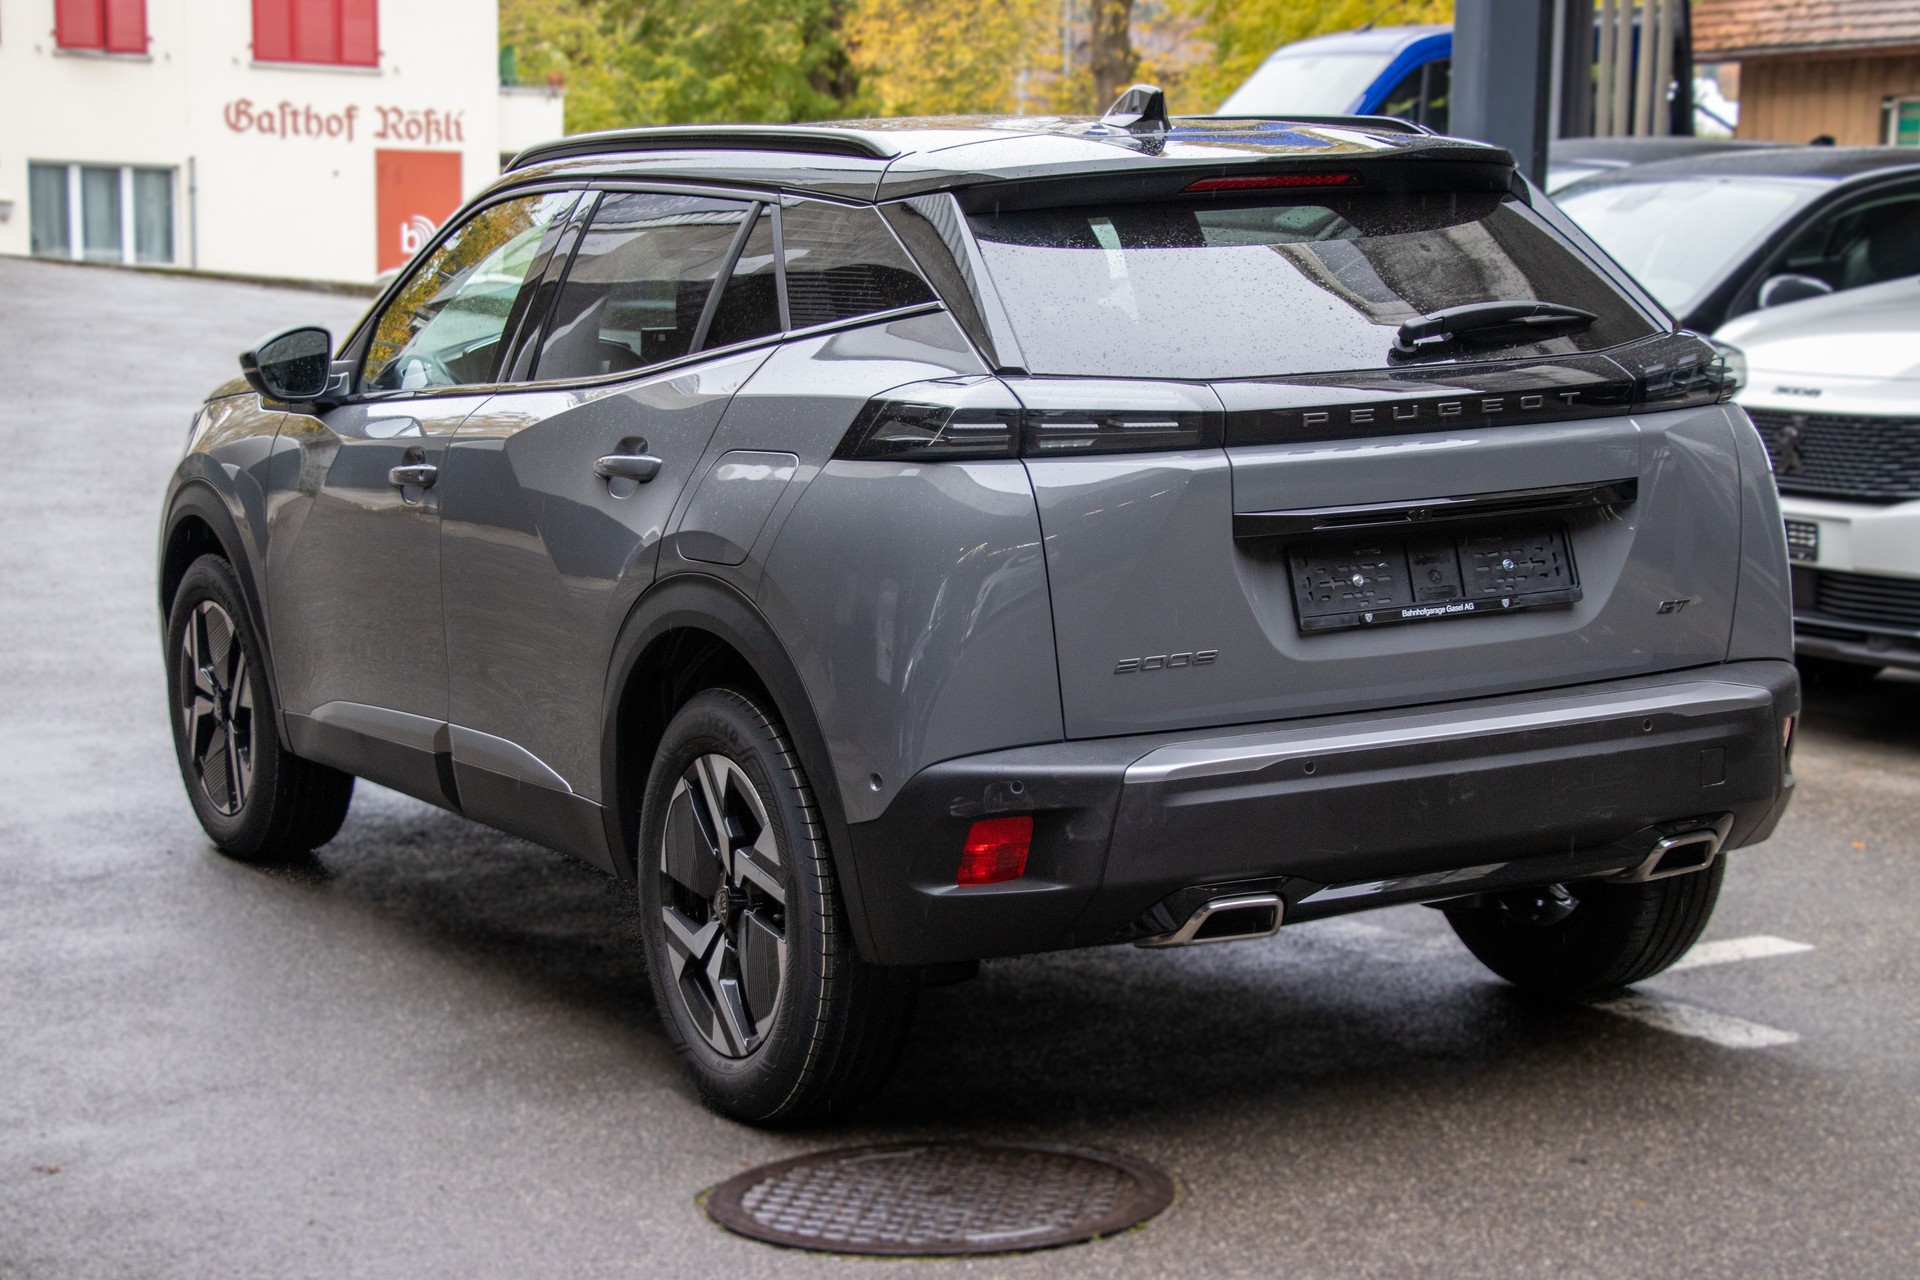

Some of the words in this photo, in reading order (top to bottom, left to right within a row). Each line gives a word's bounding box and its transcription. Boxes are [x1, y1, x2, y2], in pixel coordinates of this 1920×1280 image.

[1303, 391, 1580, 427] PEUGEOT
[1402, 607, 1446, 617] Bahnhofgarage
[1446, 604, 1463, 613] Gasel
[1464, 602, 1474, 610] AG
[1656, 599, 1690, 614] GT
[1114, 649, 1219, 674] 2008
